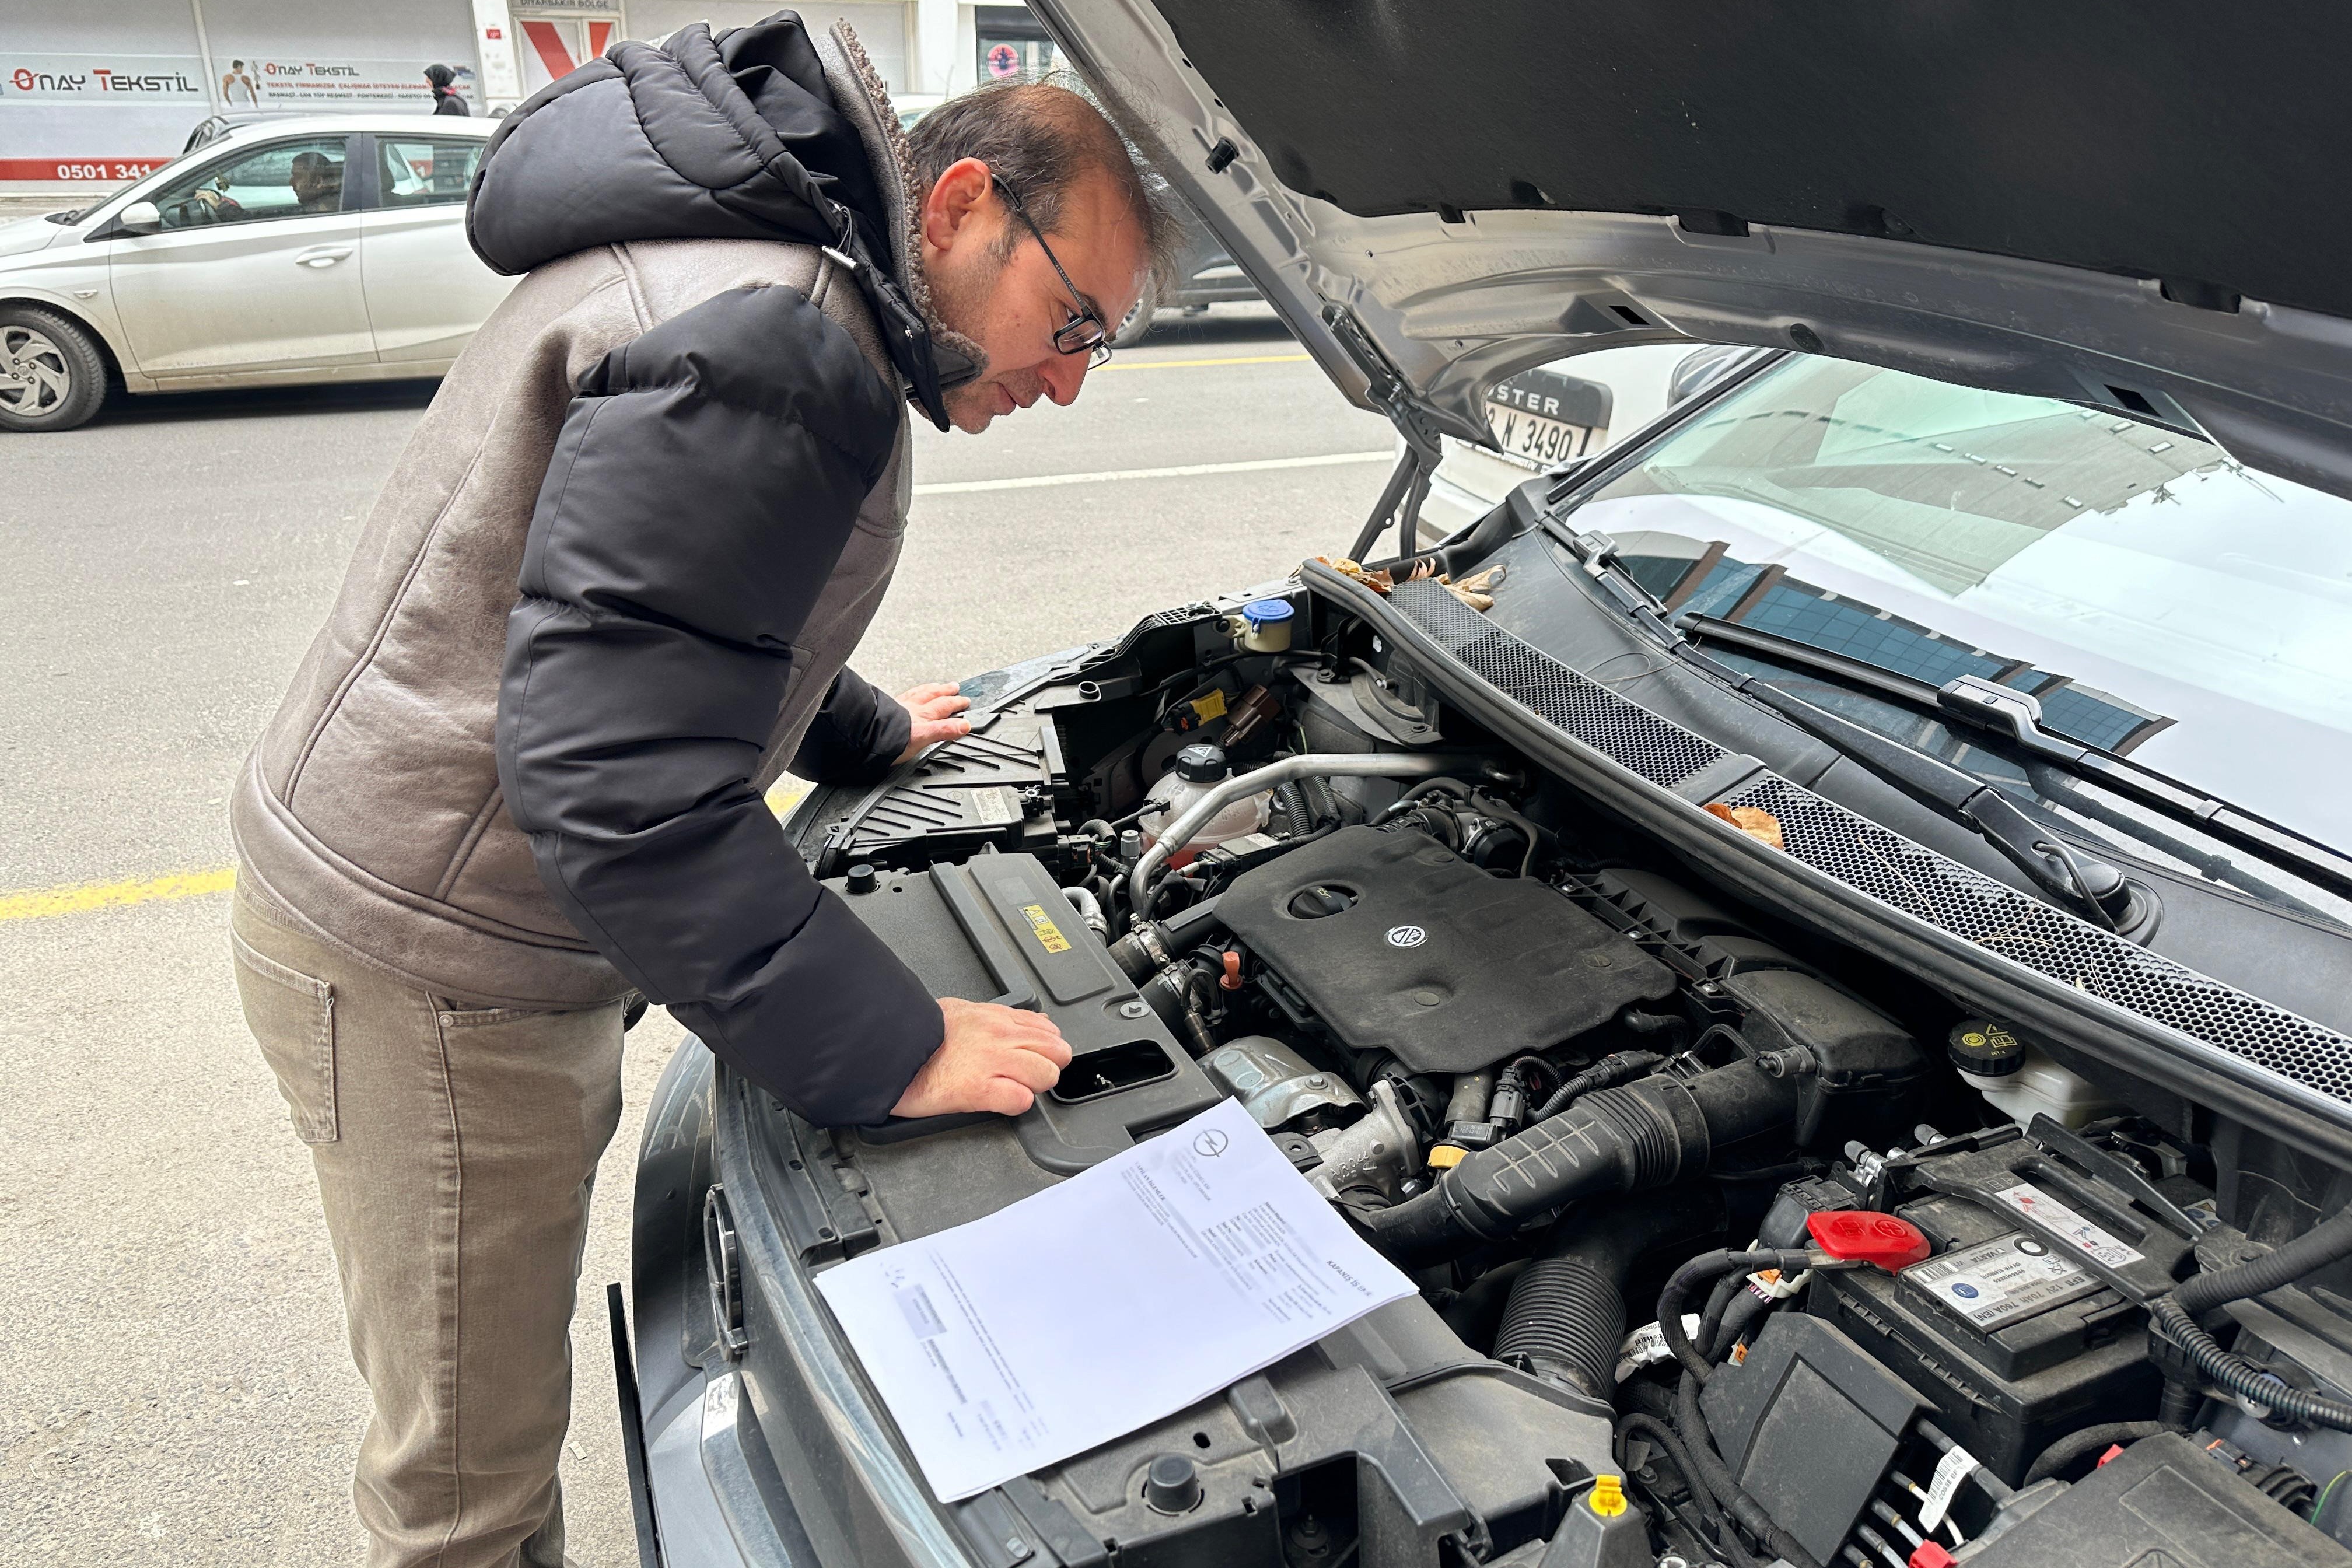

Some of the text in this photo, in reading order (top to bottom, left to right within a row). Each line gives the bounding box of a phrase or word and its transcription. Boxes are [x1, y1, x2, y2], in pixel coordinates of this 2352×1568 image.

[57, 164, 152, 180] 0501 341
[1488, 384, 1559, 415] STER
[1522, 419, 1573, 463] 3490
[1969, 1250, 1997, 1263] VARTA
[2046, 1284, 2064, 1294] 12V
[2020, 1291, 2046, 1303] 70Ah
[1973, 1308, 1996, 1321] (EN)
